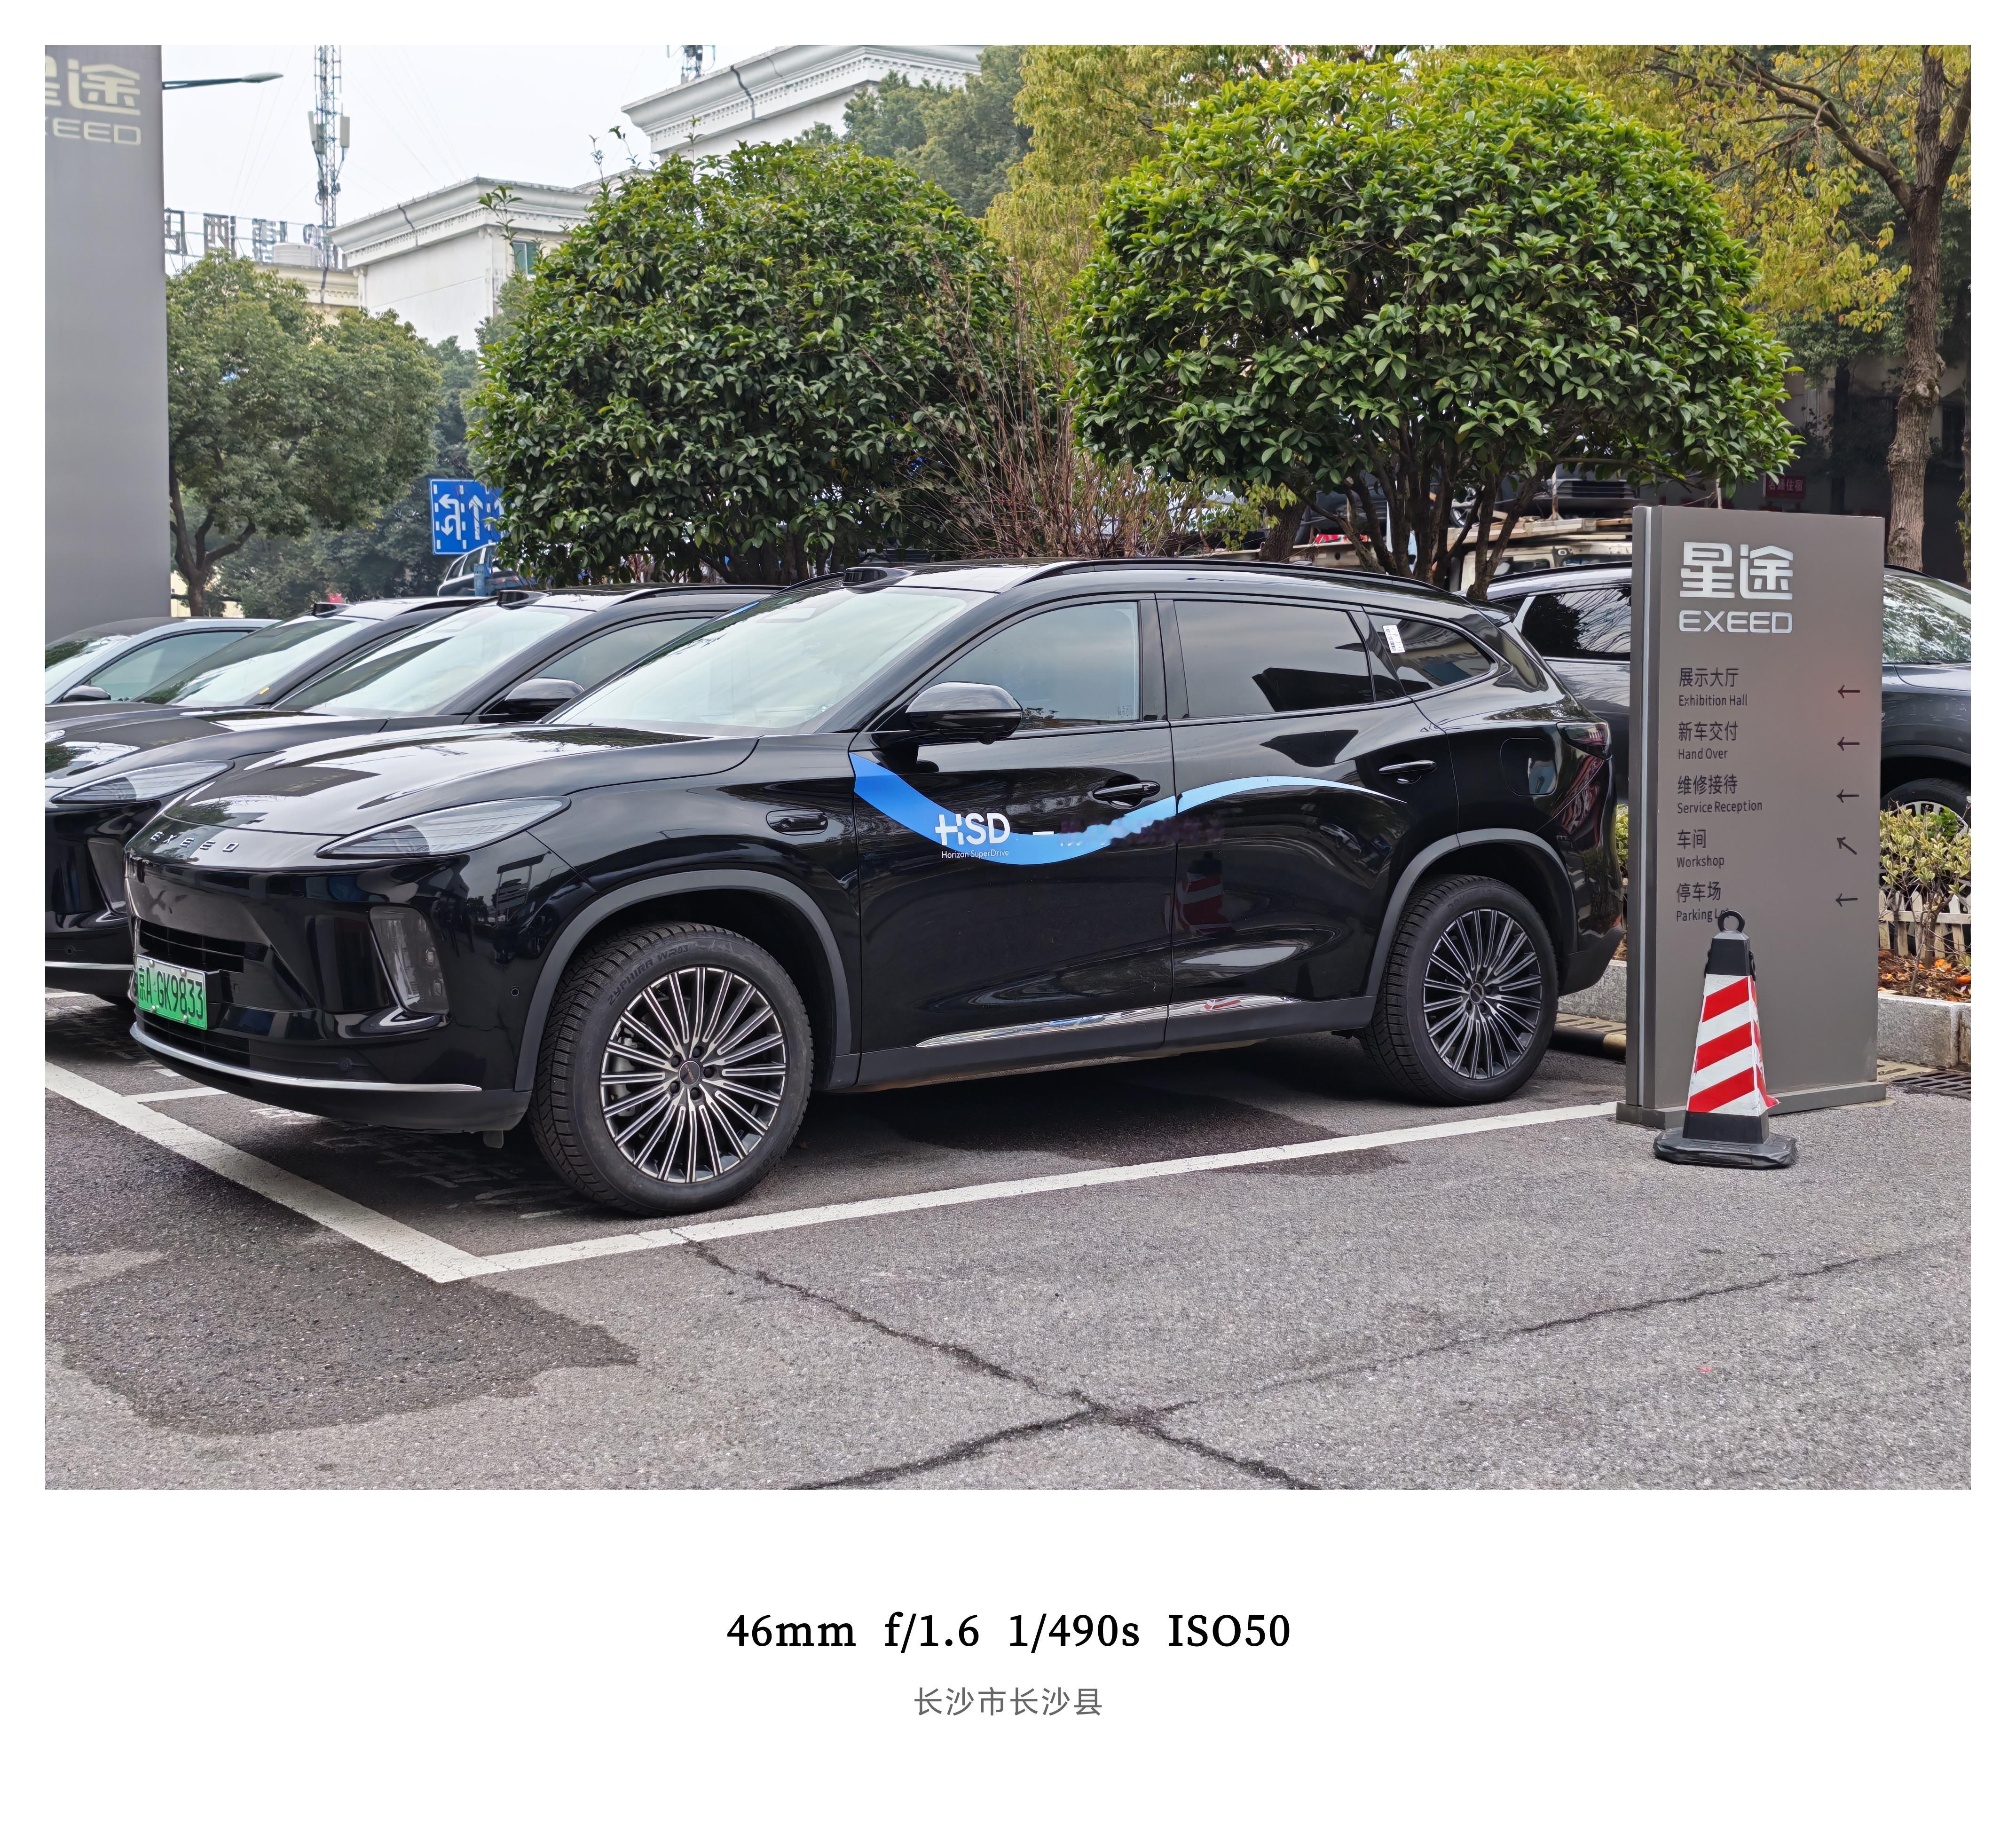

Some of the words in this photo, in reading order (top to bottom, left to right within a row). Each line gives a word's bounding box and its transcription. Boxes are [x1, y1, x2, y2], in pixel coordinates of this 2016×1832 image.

[45, 55, 141, 116] 途
[1679, 542, 1793, 600] 星途
[1679, 610, 1792, 633] EXEED
[1679, 667, 1739, 687] 展示大厅
[1679, 694, 1727, 706] Exhibition
[1729, 694, 1748, 706] Hall
[1678, 721, 1738, 742] 新车交付
[1678, 747, 1703, 759] Hand
[1706, 748, 1728, 759] Over
[1677, 774, 1738, 795] 维修接待
[1677, 801, 1712, 813] Service
[1715, 800, 1763, 814] Reception
[935, 813, 1010, 845] HSD
[1677, 829, 1706, 849] 车间
[150, 831, 240, 853] EXEED
[942, 850, 969, 859] Horizon
[970, 849, 1009, 860] SuperDrive
[1677, 855, 1725, 869] Workshop
[1676, 881, 1721, 903] 停车场
[1677, 908, 1713, 923] Parking
